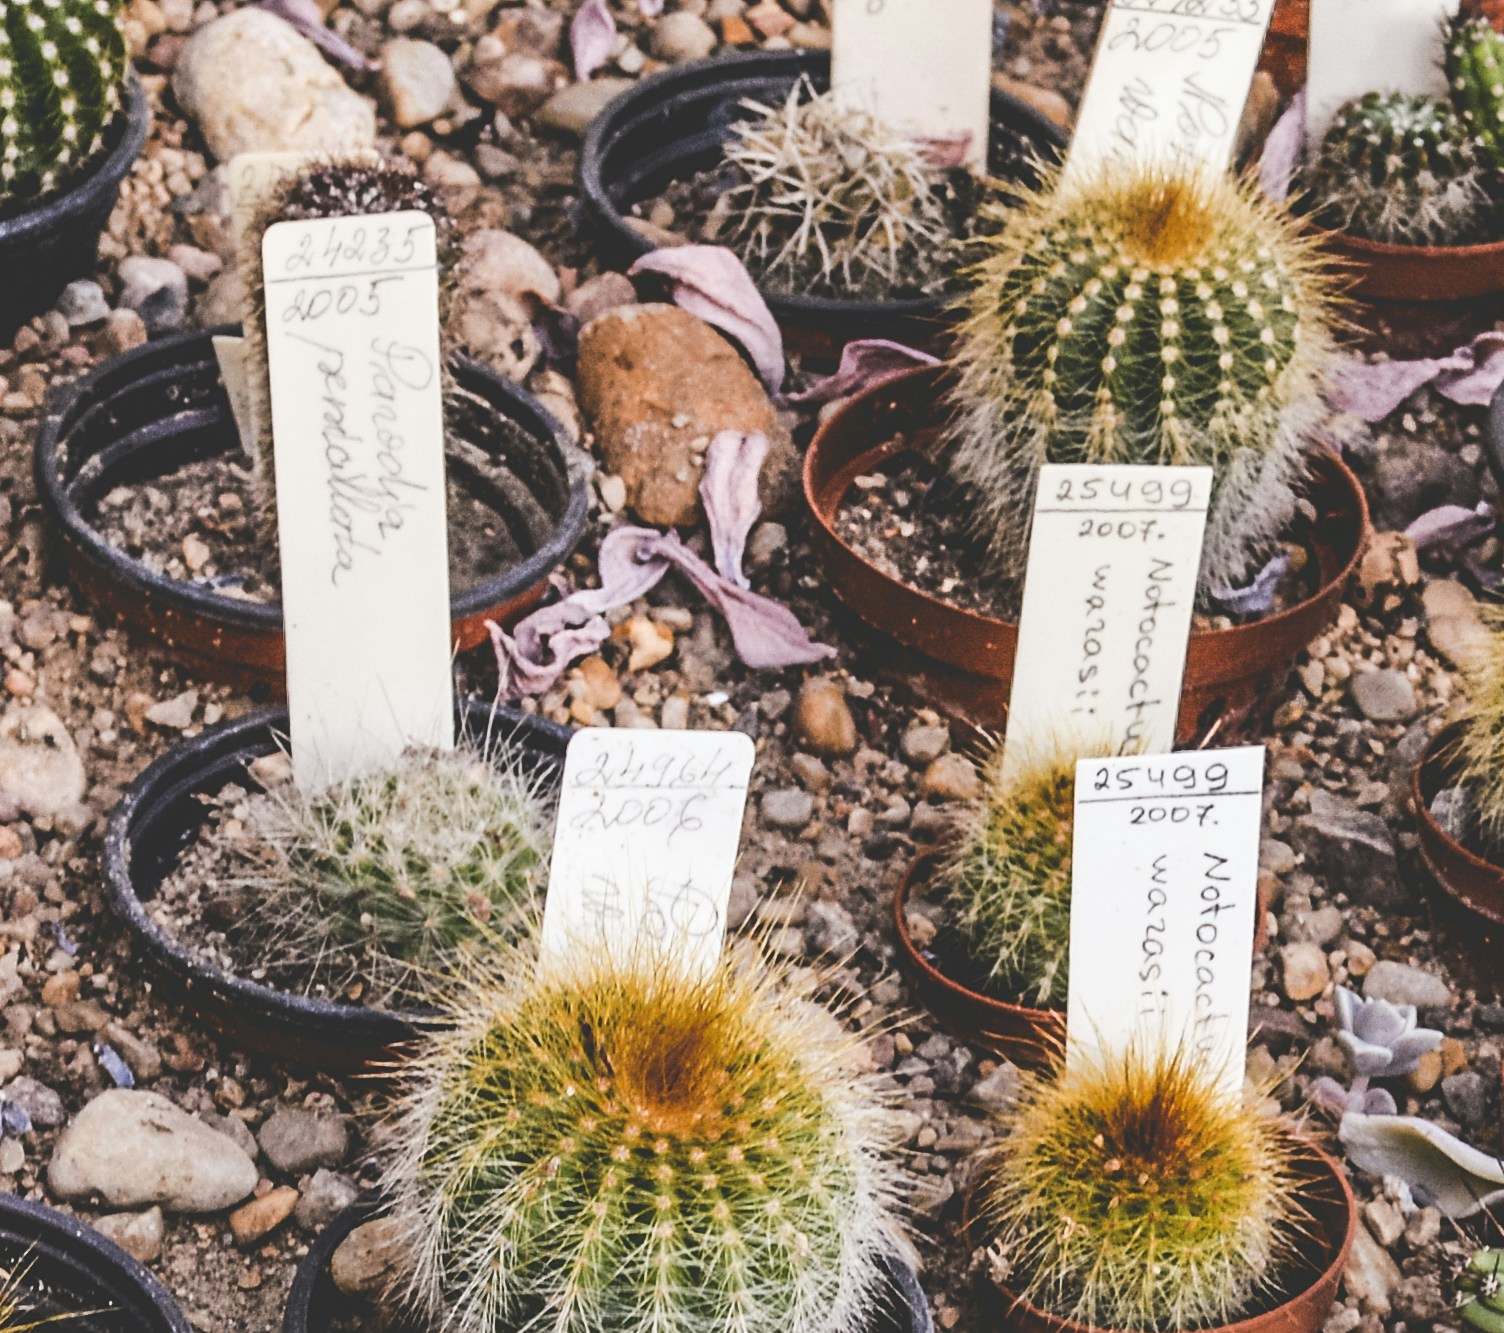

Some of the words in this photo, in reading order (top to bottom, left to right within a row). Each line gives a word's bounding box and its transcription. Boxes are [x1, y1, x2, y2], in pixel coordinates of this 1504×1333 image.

[1106, 22, 1240, 60] 2005
[282, 225, 418, 272] 24235
[282, 276, 404, 324] 2005
[371, 337, 436, 543] Parodia
[1055, 478, 1194, 511] 25499
[575, 746, 734, 790] 24964
[1093, 762, 1230, 796] 25499
[570, 791, 706, 838] 2006
